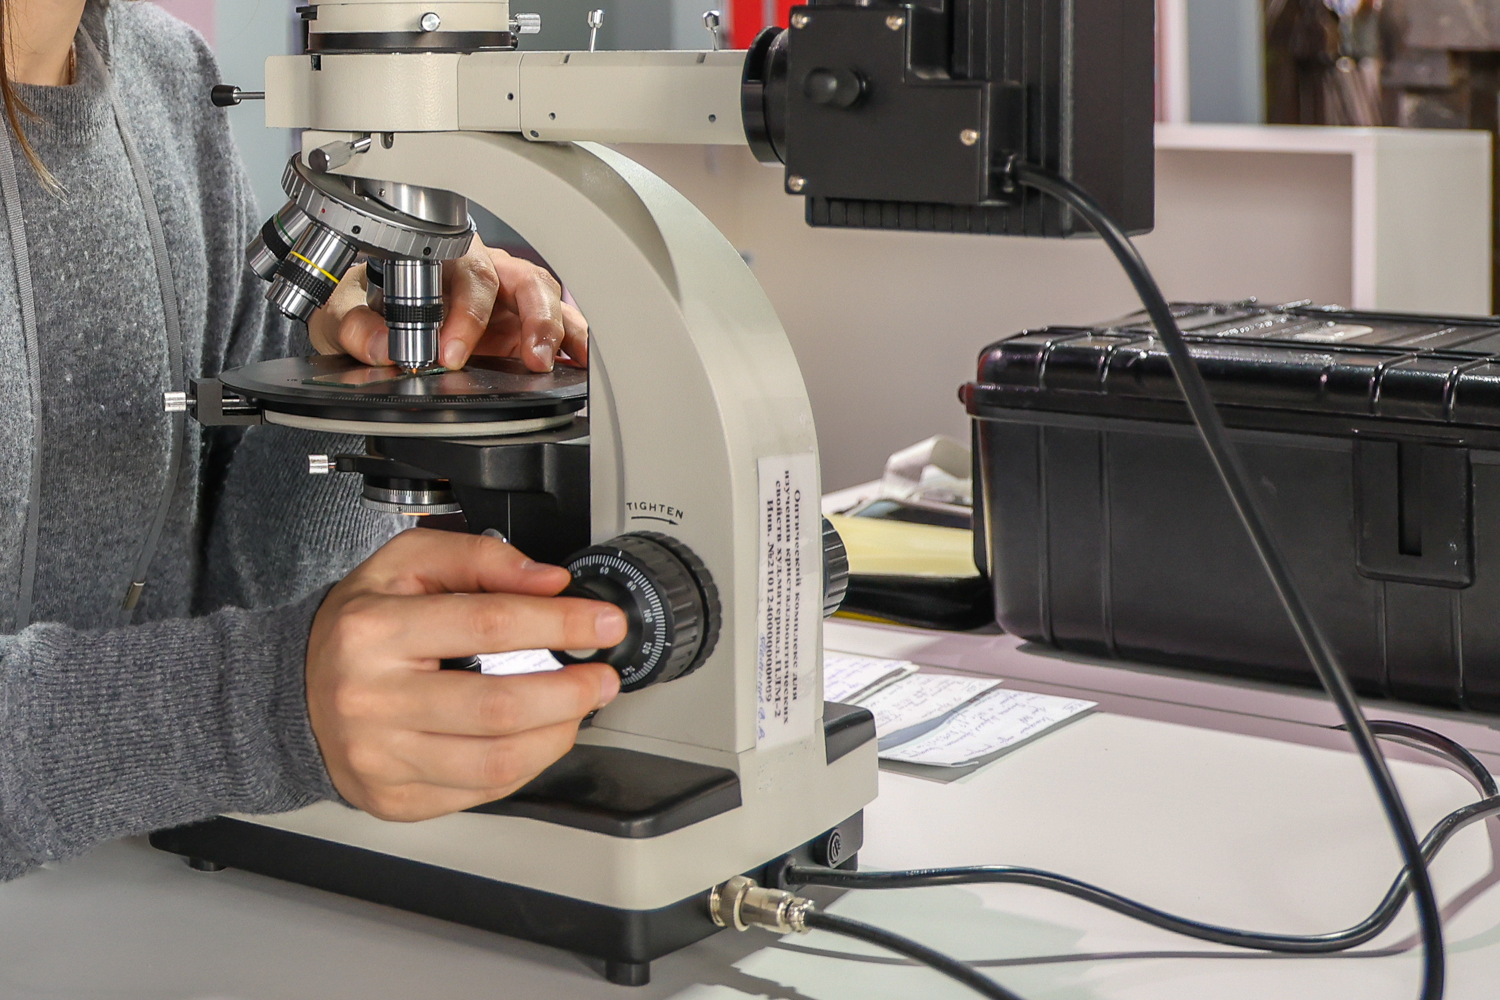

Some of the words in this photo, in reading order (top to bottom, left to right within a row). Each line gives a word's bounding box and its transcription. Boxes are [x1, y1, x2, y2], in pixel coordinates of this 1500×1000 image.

[626, 502, 684, 519] TIGHTEN
[766, 499, 774, 537] Инв.
[775, 480, 783, 542] свойств
[783, 470, 791, 542] изучения
[793, 489, 802, 587] Оптический
[600, 566, 609, 575] 60
[626, 580, 637, 591] 80
[643, 609, 653, 623] 100
[792, 591, 801, 668] комплекс
[642, 641, 652, 655] 120
[783, 548, 792, 724] кристаллооптических
